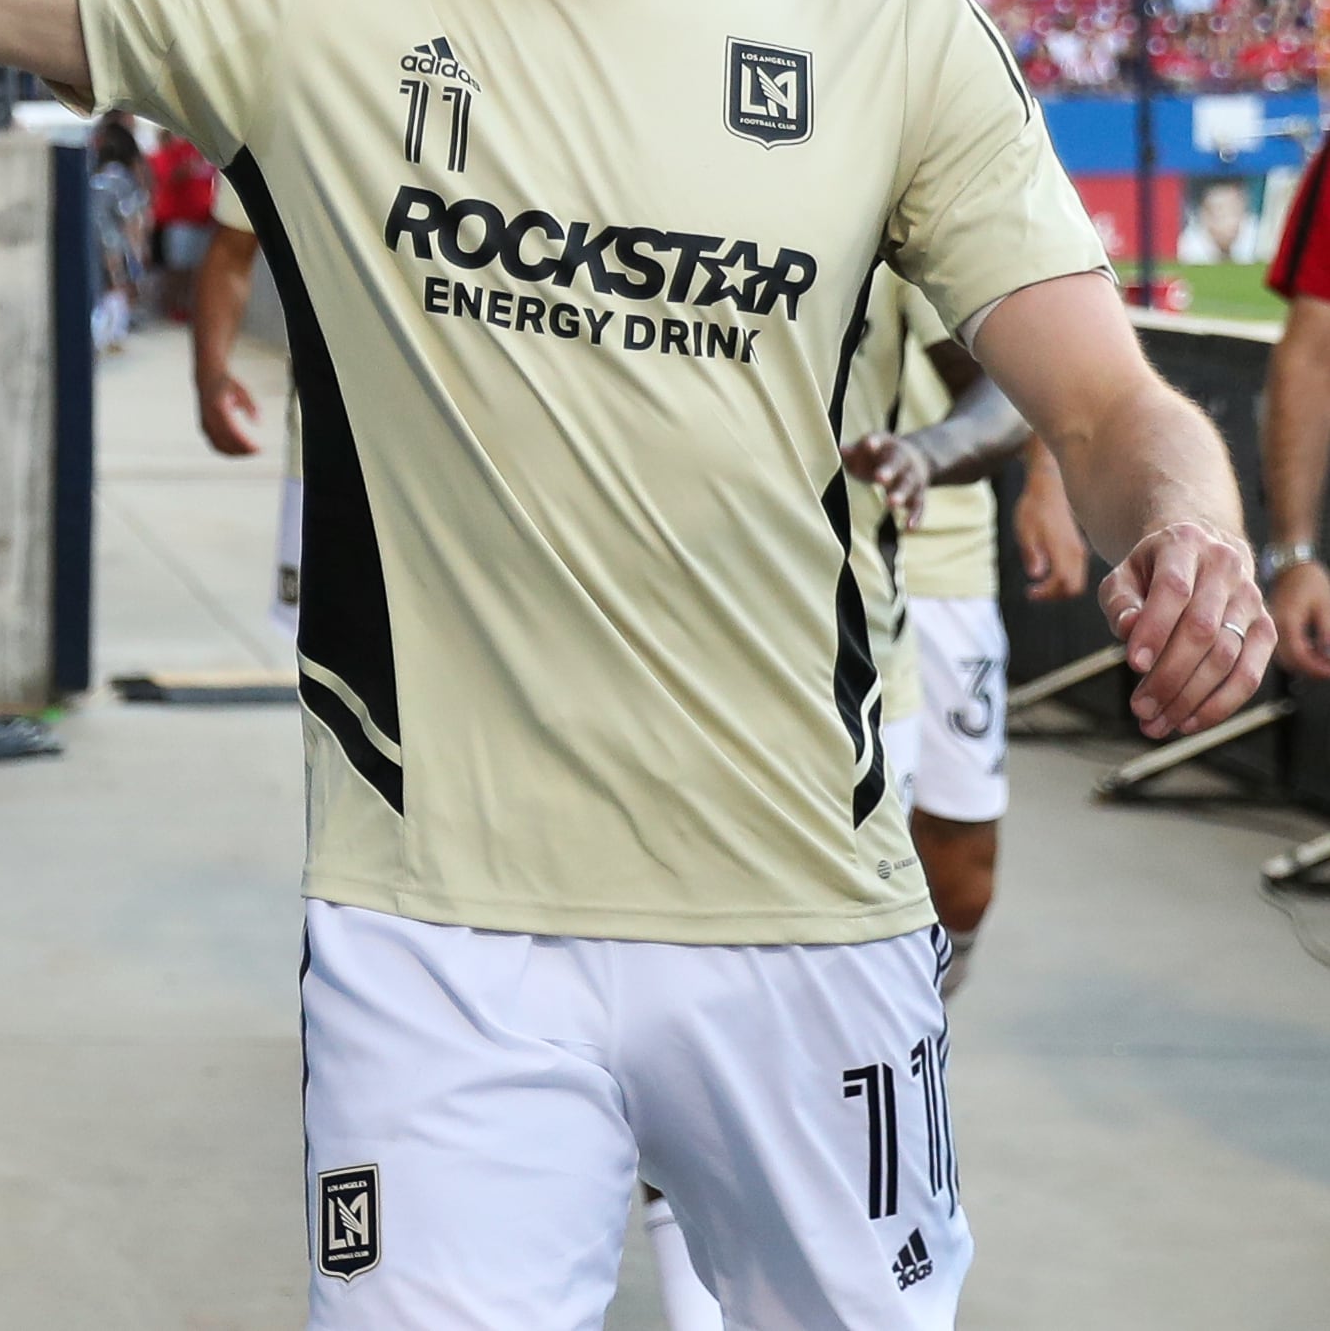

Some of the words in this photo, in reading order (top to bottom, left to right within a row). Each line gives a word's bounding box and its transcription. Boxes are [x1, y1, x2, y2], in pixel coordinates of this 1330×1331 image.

[741, 52, 758, 62] LOS
[759, 55, 797, 68] ANGELES
[399, 79, 472, 173] 11
[777, 122, 797, 131] CLUB
[384, 185, 818, 321] ROCKSTAR
[424, 276, 614, 345] ENERGY
[842, 1035, 943, 1220] 11
